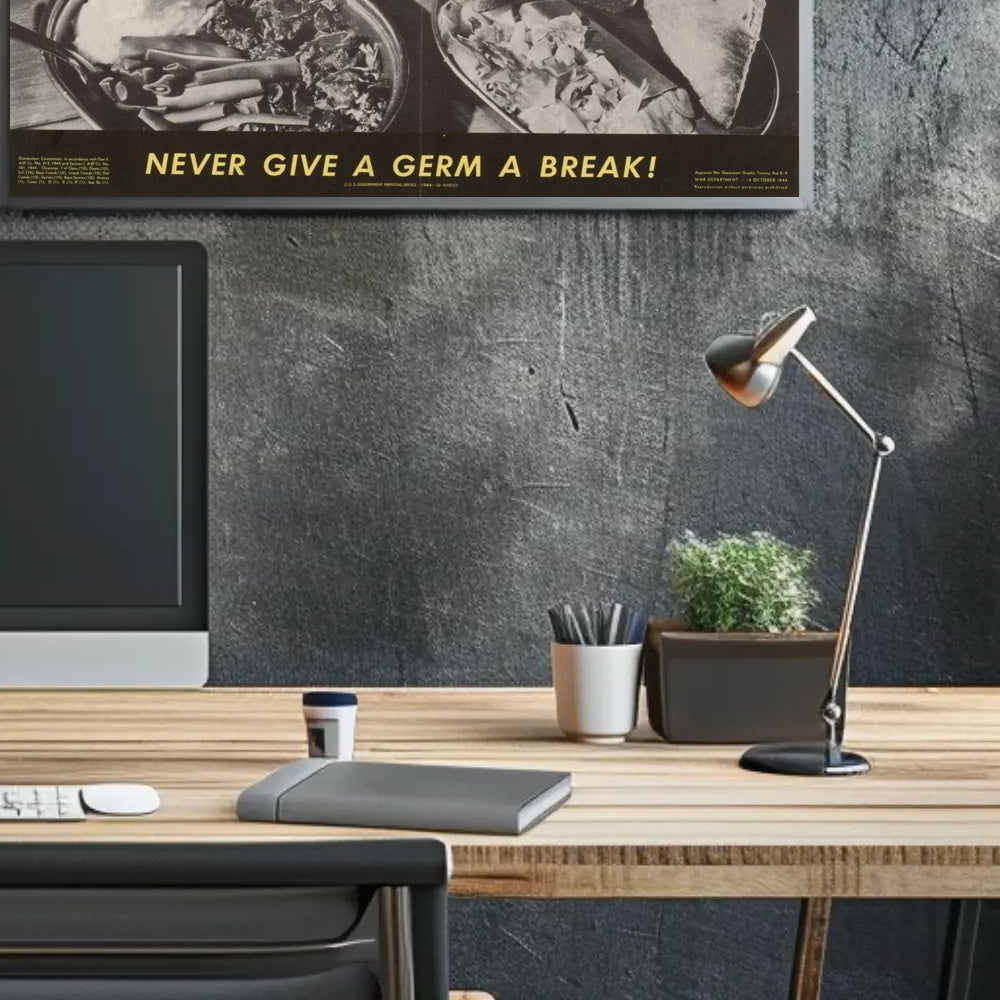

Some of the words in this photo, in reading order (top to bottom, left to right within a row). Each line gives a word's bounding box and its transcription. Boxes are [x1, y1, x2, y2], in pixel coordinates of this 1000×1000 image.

[145, 152, 246, 176] NEVER
[263, 153, 339, 177] GIVE
[351, 154, 375, 177] A
[392, 154, 482, 178] GERM
[498, 155, 521, 178] A
[539, 155, 657, 179] BREAK!
